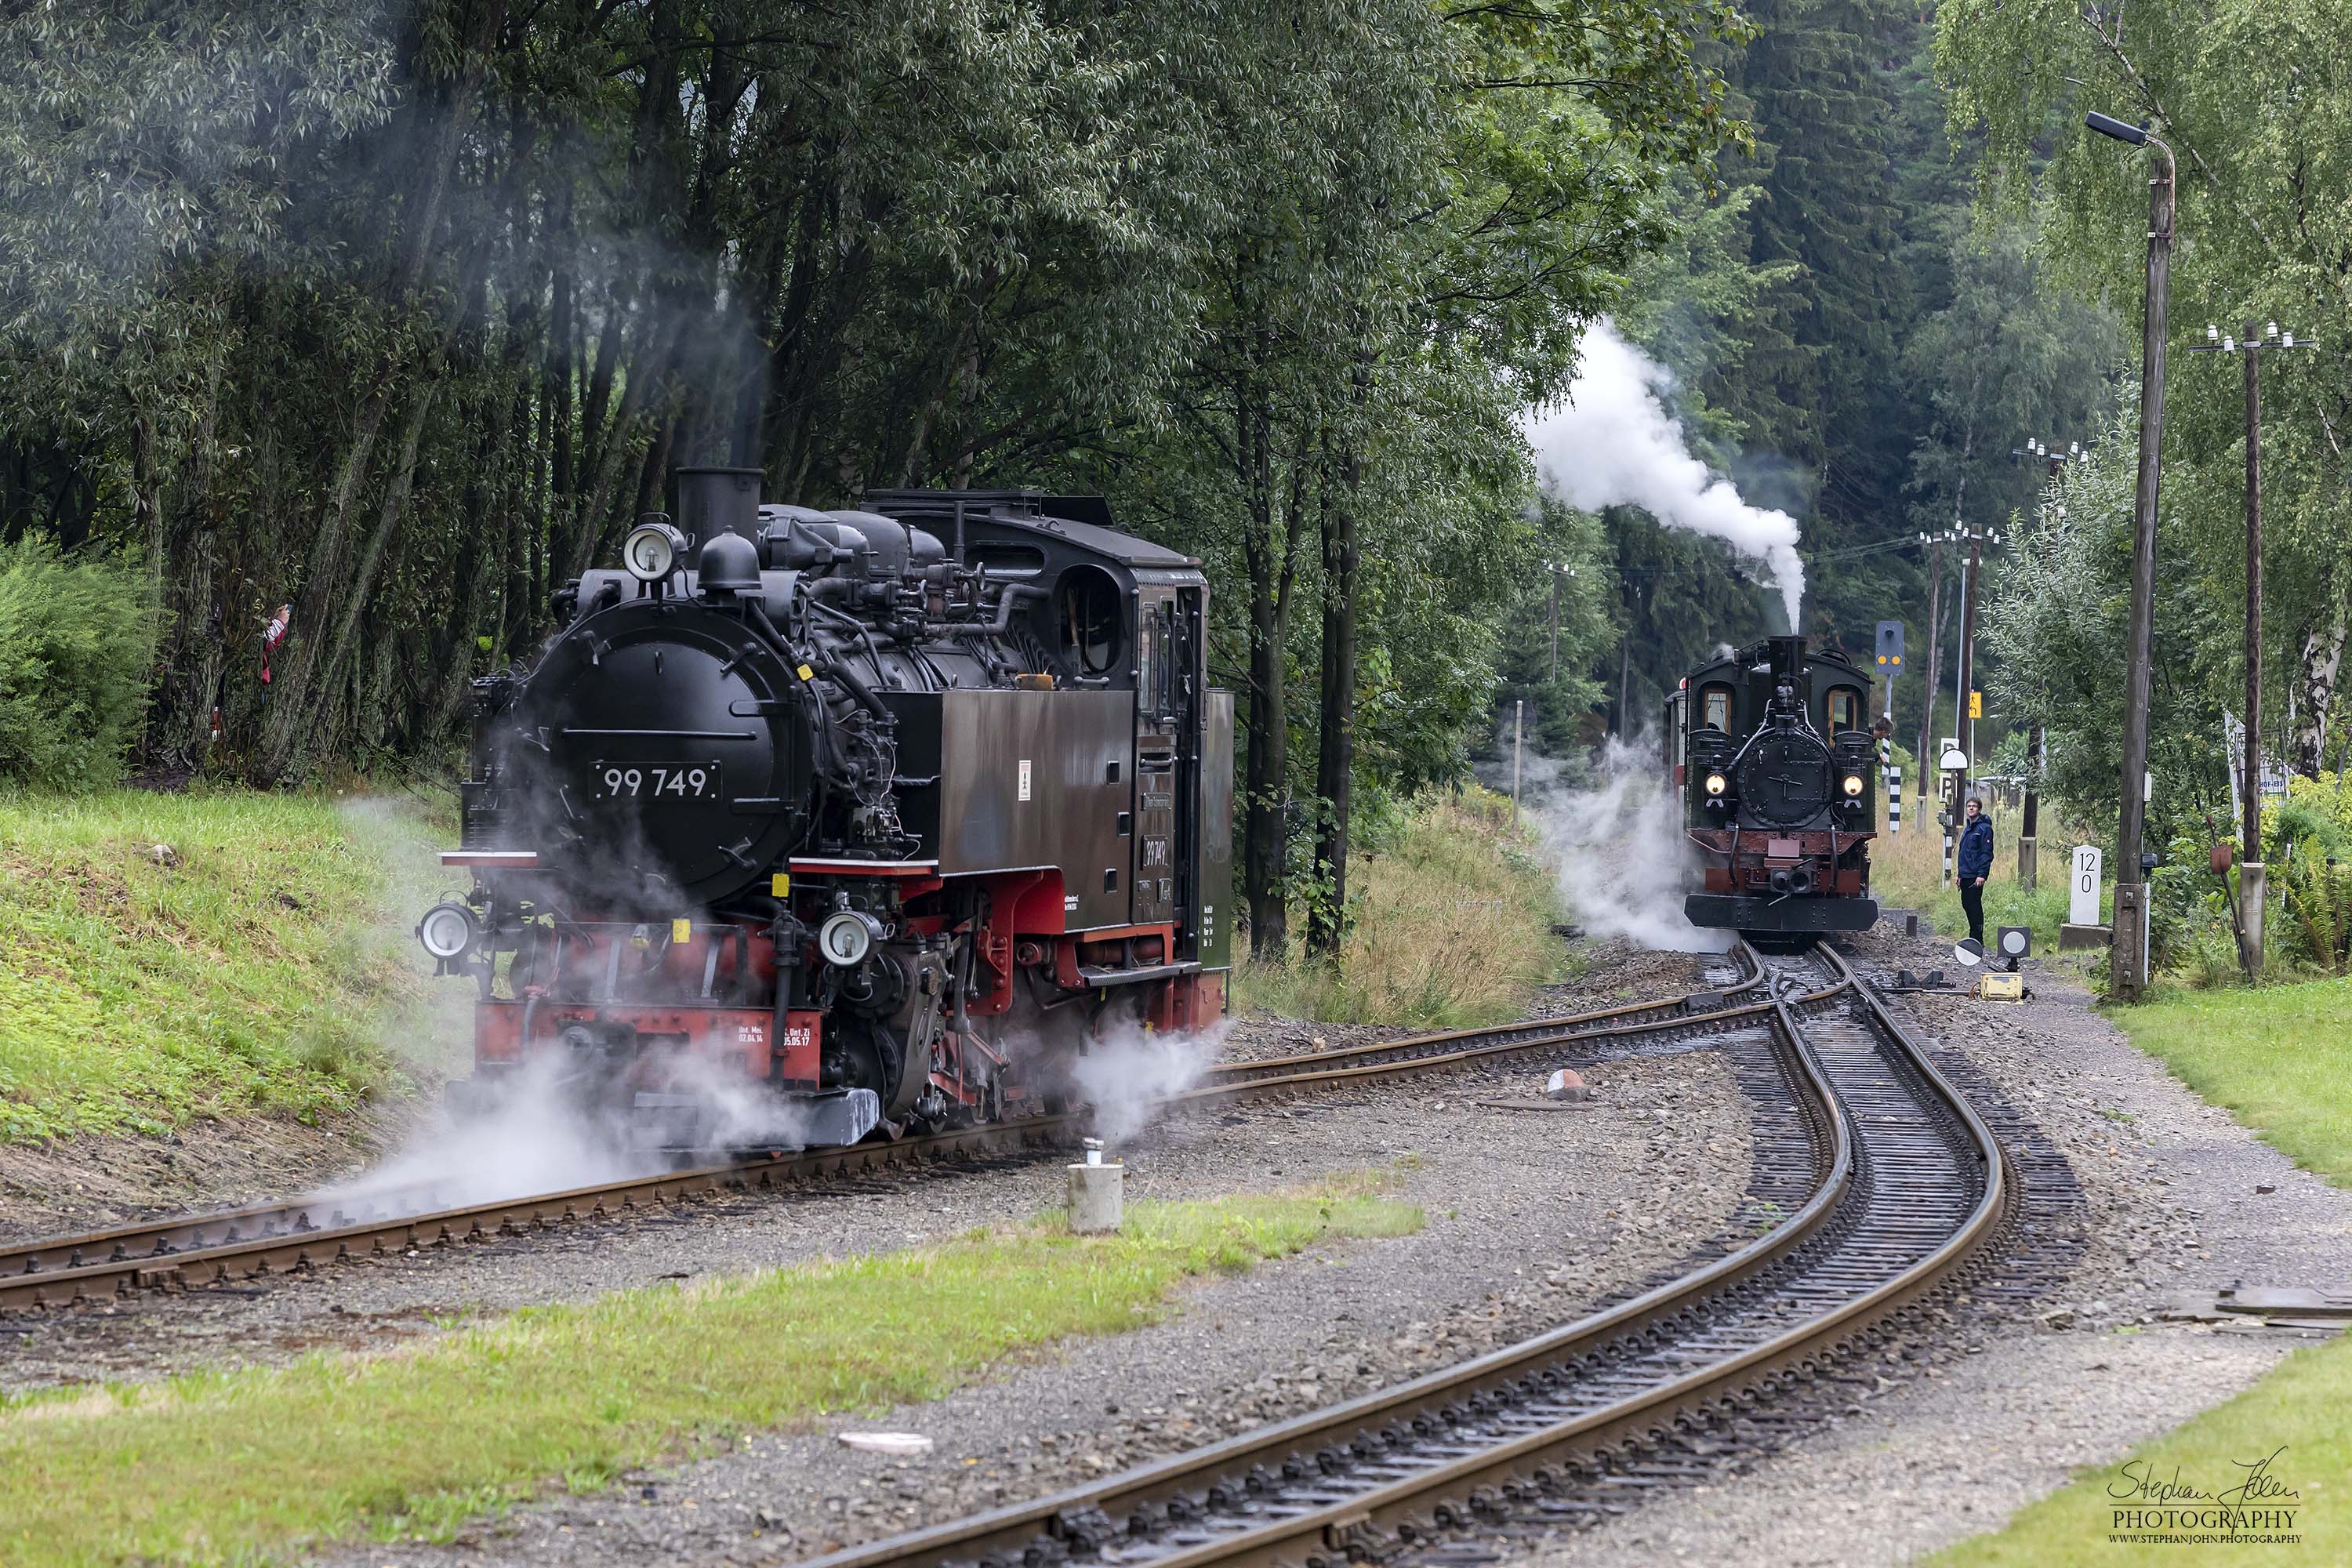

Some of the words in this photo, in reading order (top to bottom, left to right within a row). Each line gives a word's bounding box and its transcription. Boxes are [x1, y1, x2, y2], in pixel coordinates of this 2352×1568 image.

[604, 768, 642, 797] 99
[652, 769, 706, 797] 749
[1942, 778, 1952, 798] P
[2080, 853, 2095, 872] 12
[2082, 874, 2092, 893] 0
